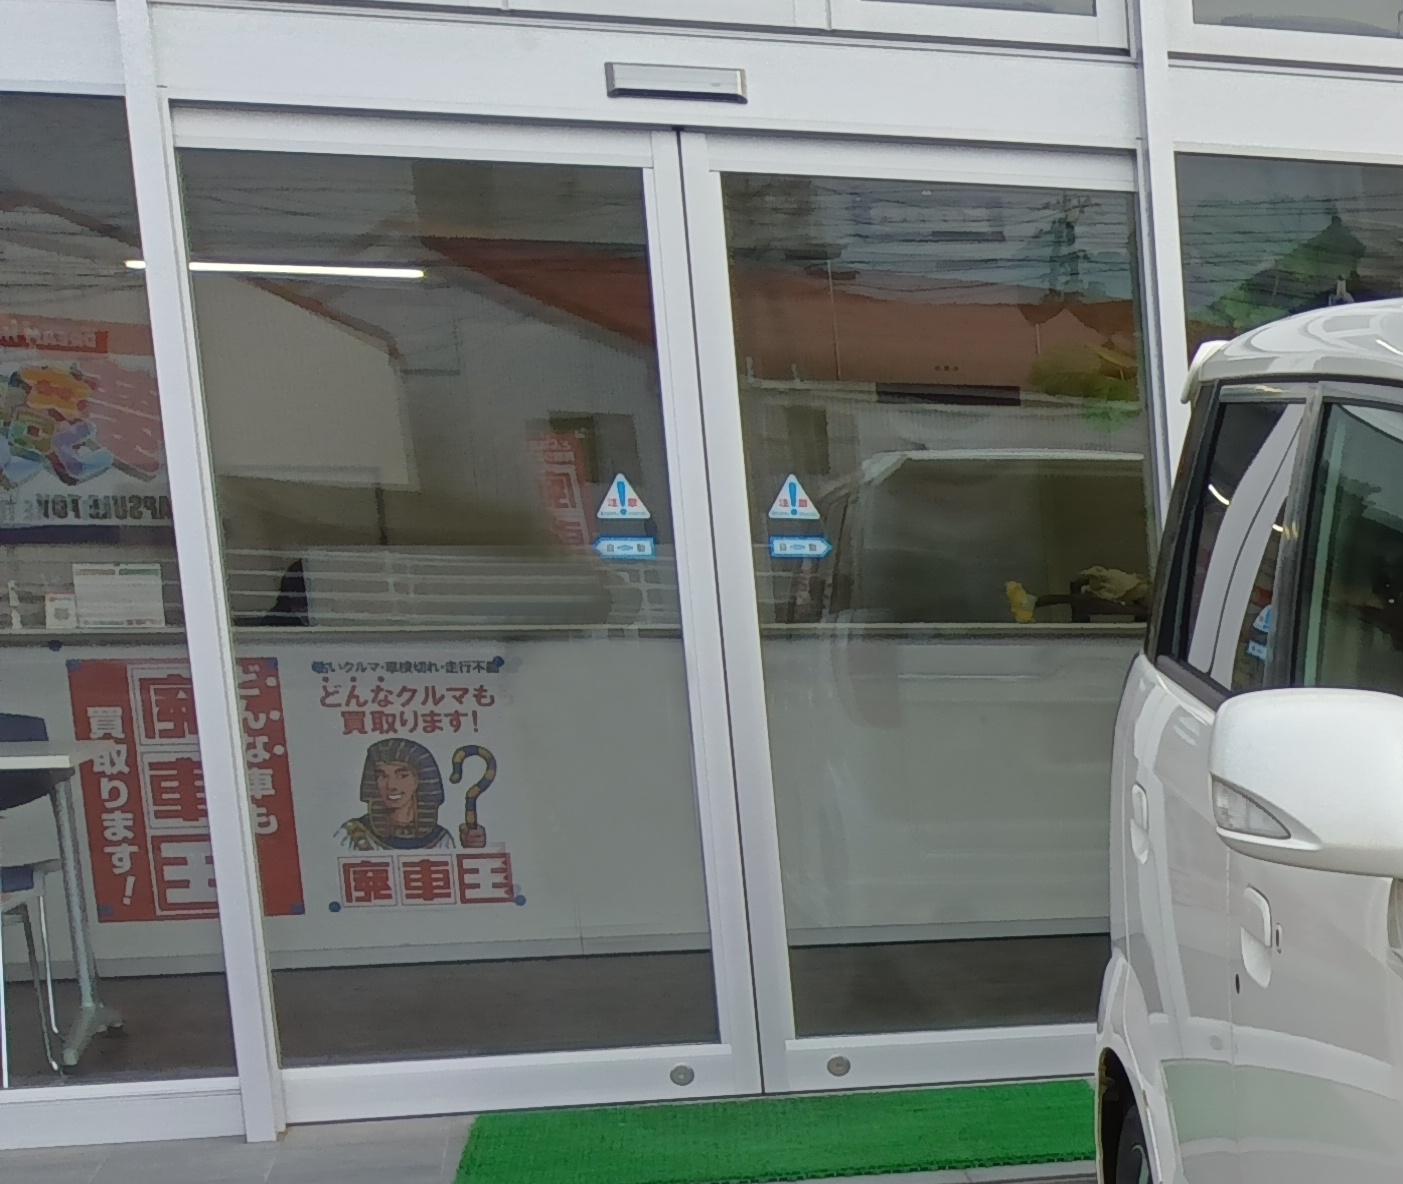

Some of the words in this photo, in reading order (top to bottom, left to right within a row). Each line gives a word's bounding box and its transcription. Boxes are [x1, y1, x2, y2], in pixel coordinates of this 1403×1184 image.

[319, 682, 495, 709] どんなクルマも
[340, 709, 480, 736] 買取ります!
